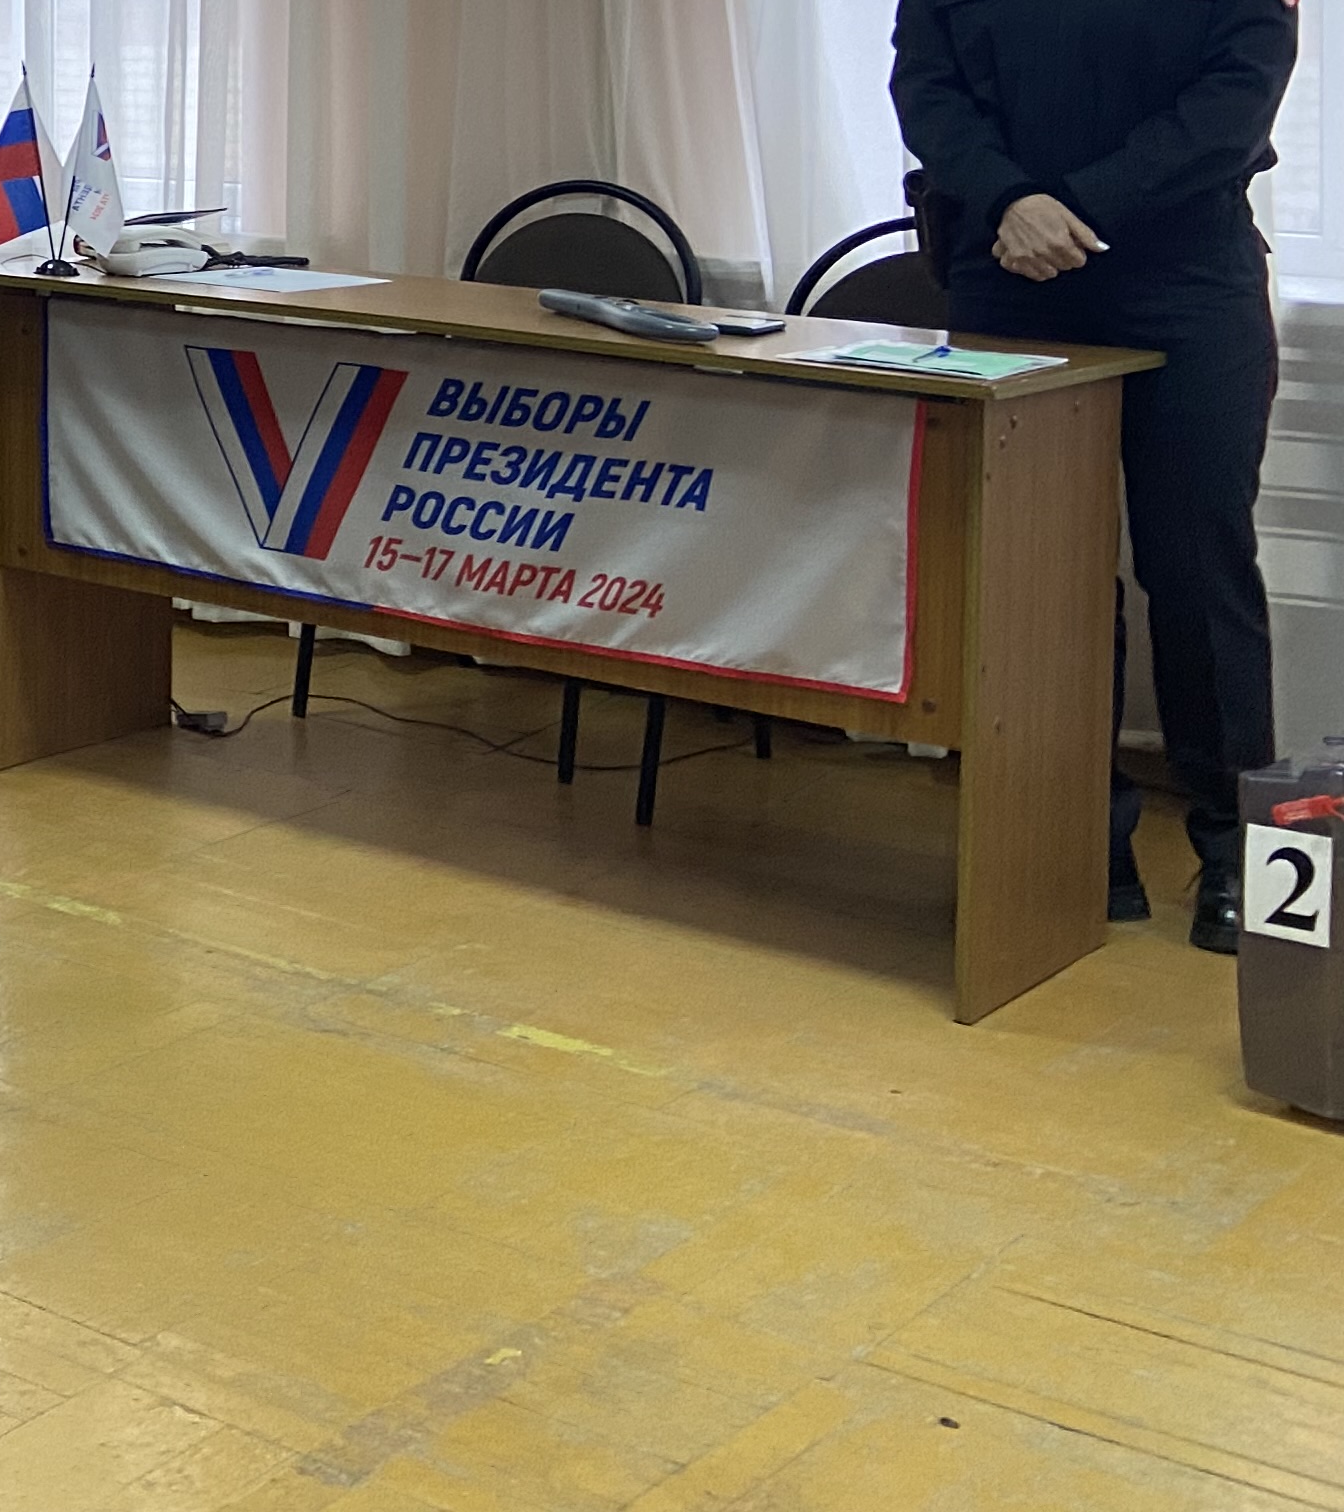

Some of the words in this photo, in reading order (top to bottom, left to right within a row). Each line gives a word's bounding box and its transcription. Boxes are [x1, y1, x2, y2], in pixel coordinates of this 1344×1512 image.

[426, 378, 651, 442] ВЫБОРЫ
[402, 432, 714, 512] ПРЕЗИДЕНТА
[381, 484, 575, 552] РОССИИ
[454, 554, 578, 604] МАРТА
[577, 573, 666, 618] 2024
[1265, 847, 1319, 932] 2
